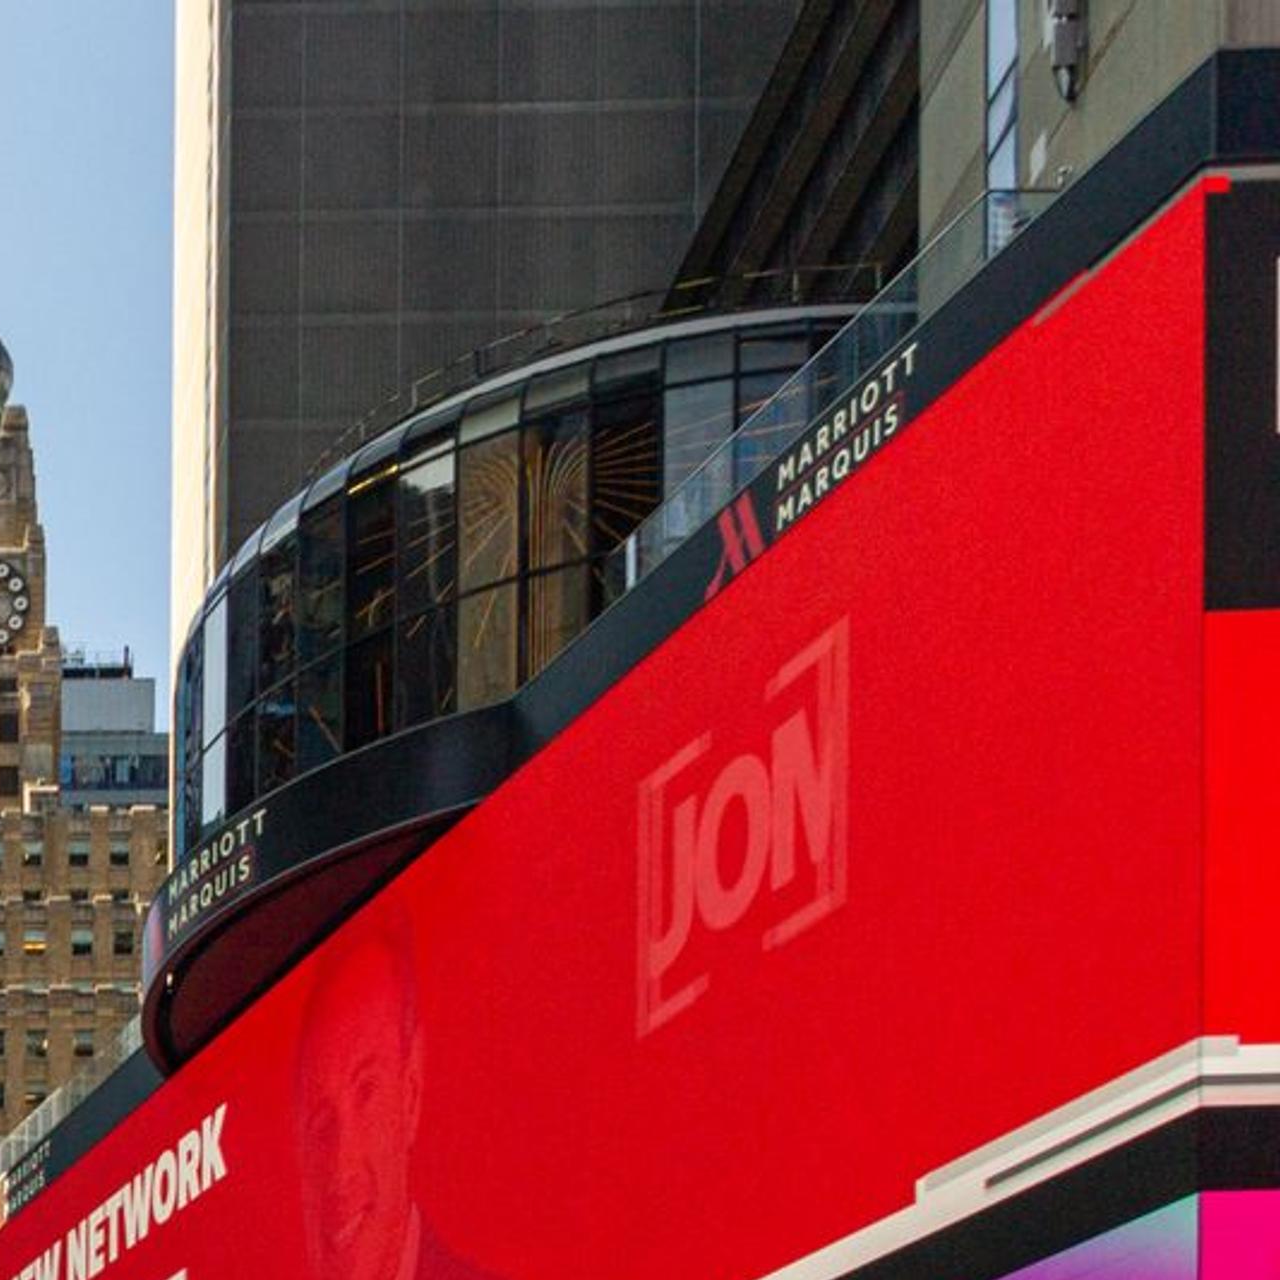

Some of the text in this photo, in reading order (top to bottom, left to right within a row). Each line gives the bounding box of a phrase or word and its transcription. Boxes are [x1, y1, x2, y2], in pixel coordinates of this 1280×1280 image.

[776, 342, 918, 493] MARRIOTT
[776, 404, 900, 532] MARQUIS
[168, 855, 251, 941] MARQUIS
[169, 808, 267, 905] MARRIOTT
